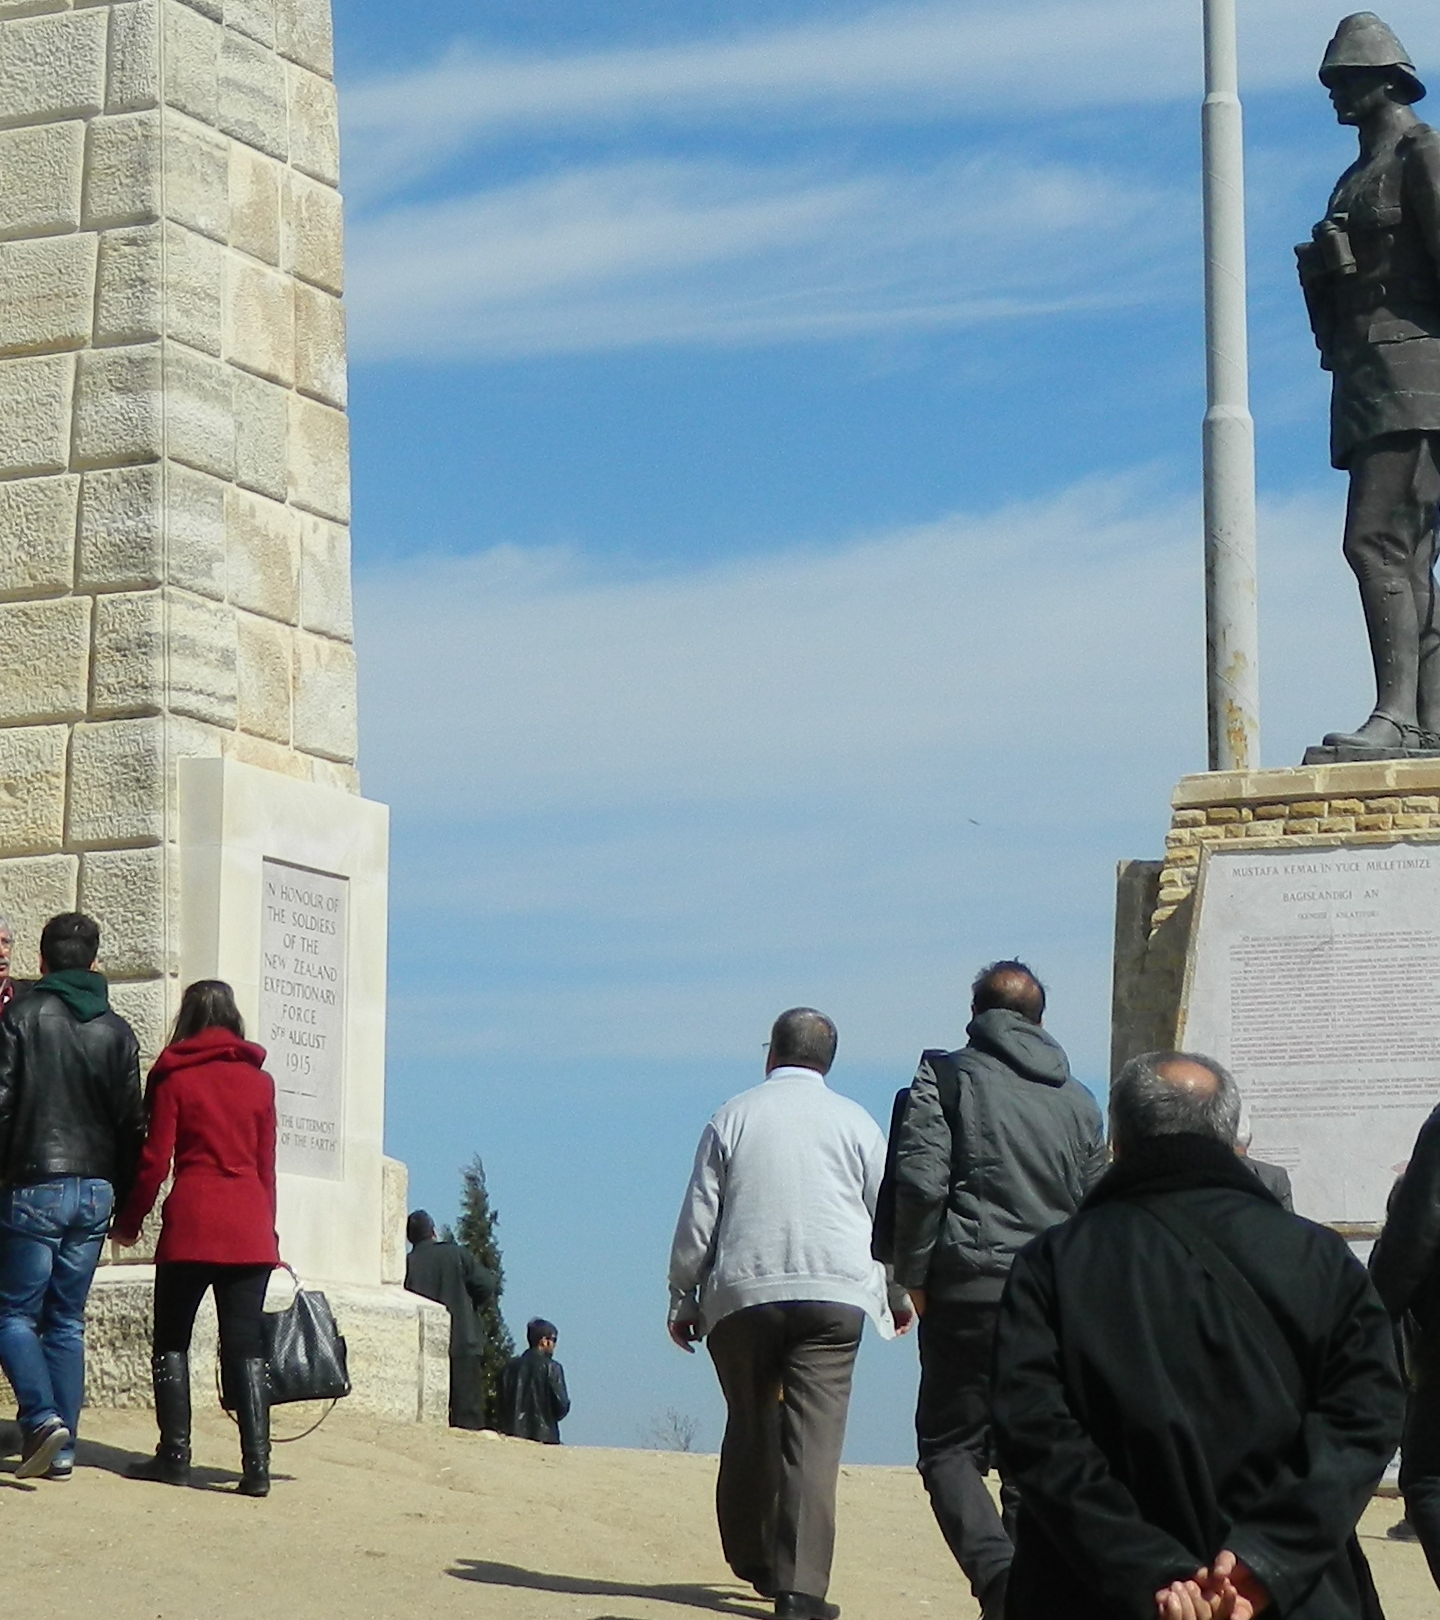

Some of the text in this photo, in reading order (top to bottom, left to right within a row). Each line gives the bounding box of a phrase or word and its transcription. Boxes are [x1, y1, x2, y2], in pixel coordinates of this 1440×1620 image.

[1232, 867, 1279, 877] MUSTAFA
[281, 885, 323, 910] HONOUR
[326, 897, 339, 913] OF
[267, 905, 336, 935] THE SOLDIERS
[283, 933, 319, 955] OF THE
[264, 952, 338, 982] NEW ZEALAND
[264, 976, 336, 1006] EXPEDITIONARY
[281, 1003, 317, 1025] FORCE
[289, 1030, 326, 1050] AUGUST
[287, 1052, 311, 1075] 1915
[281, 1114, 293, 1129] THE
[281, 1132, 290, 1145] OF
[294, 1133, 307, 1148] THE
